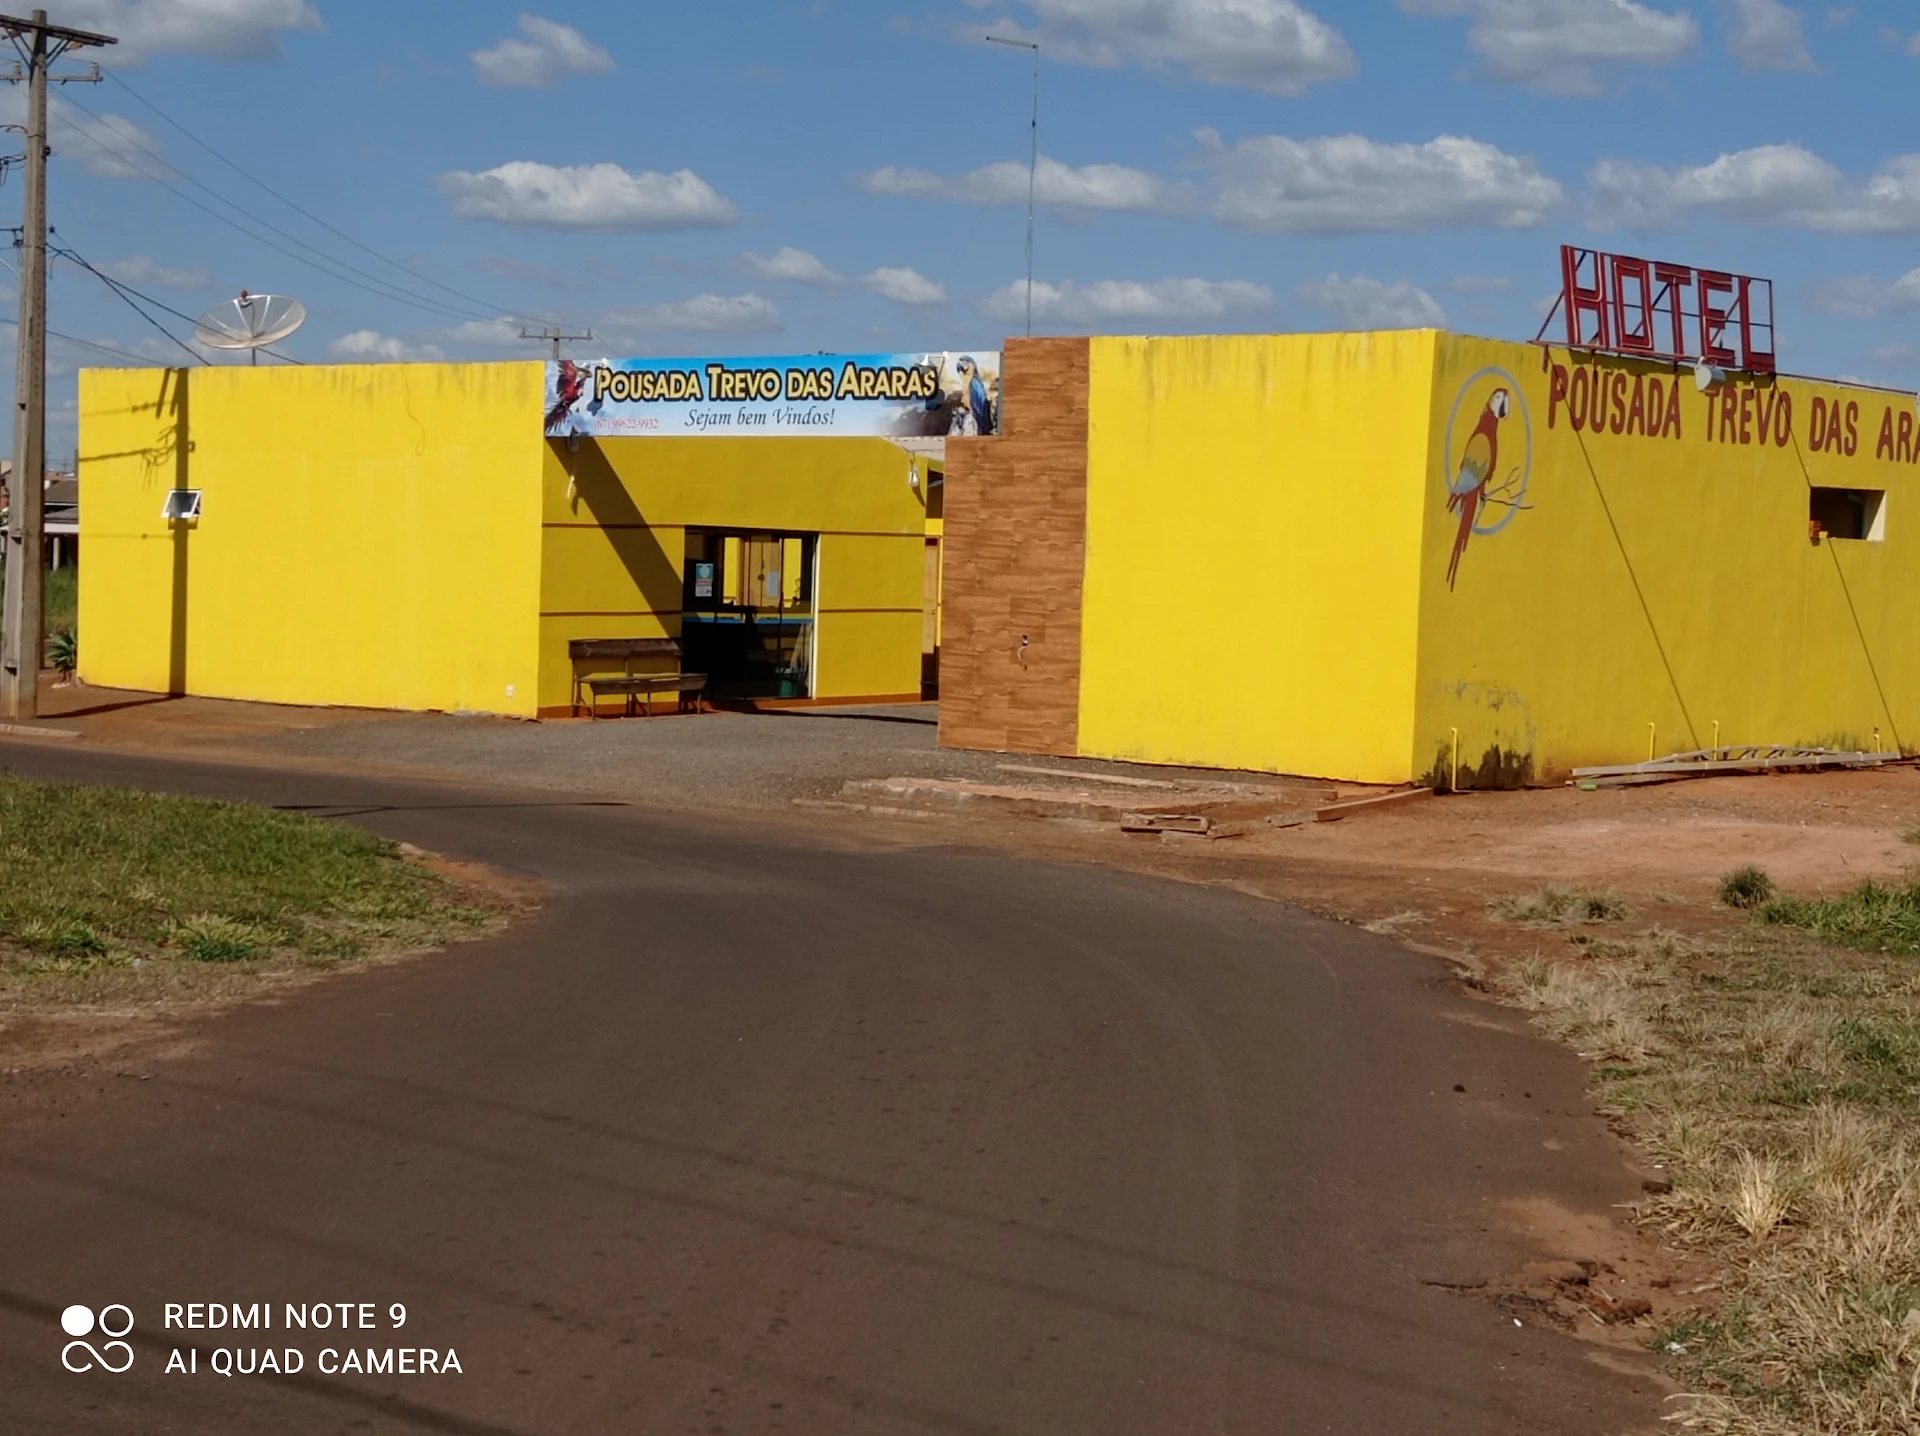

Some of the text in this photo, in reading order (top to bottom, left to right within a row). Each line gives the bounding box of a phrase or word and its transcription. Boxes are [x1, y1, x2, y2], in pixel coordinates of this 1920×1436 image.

[1561, 245, 1776, 374] HOTEL
[594, 361, 940, 402] POUSADA TREVO DAS ARARAS
[1548, 365, 1681, 440] POUSADA
[1705, 386, 1792, 448] TREVO
[1809, 397, 1859, 457] DAS
[684, 405, 836, 431] Sejam bem Vindos!
